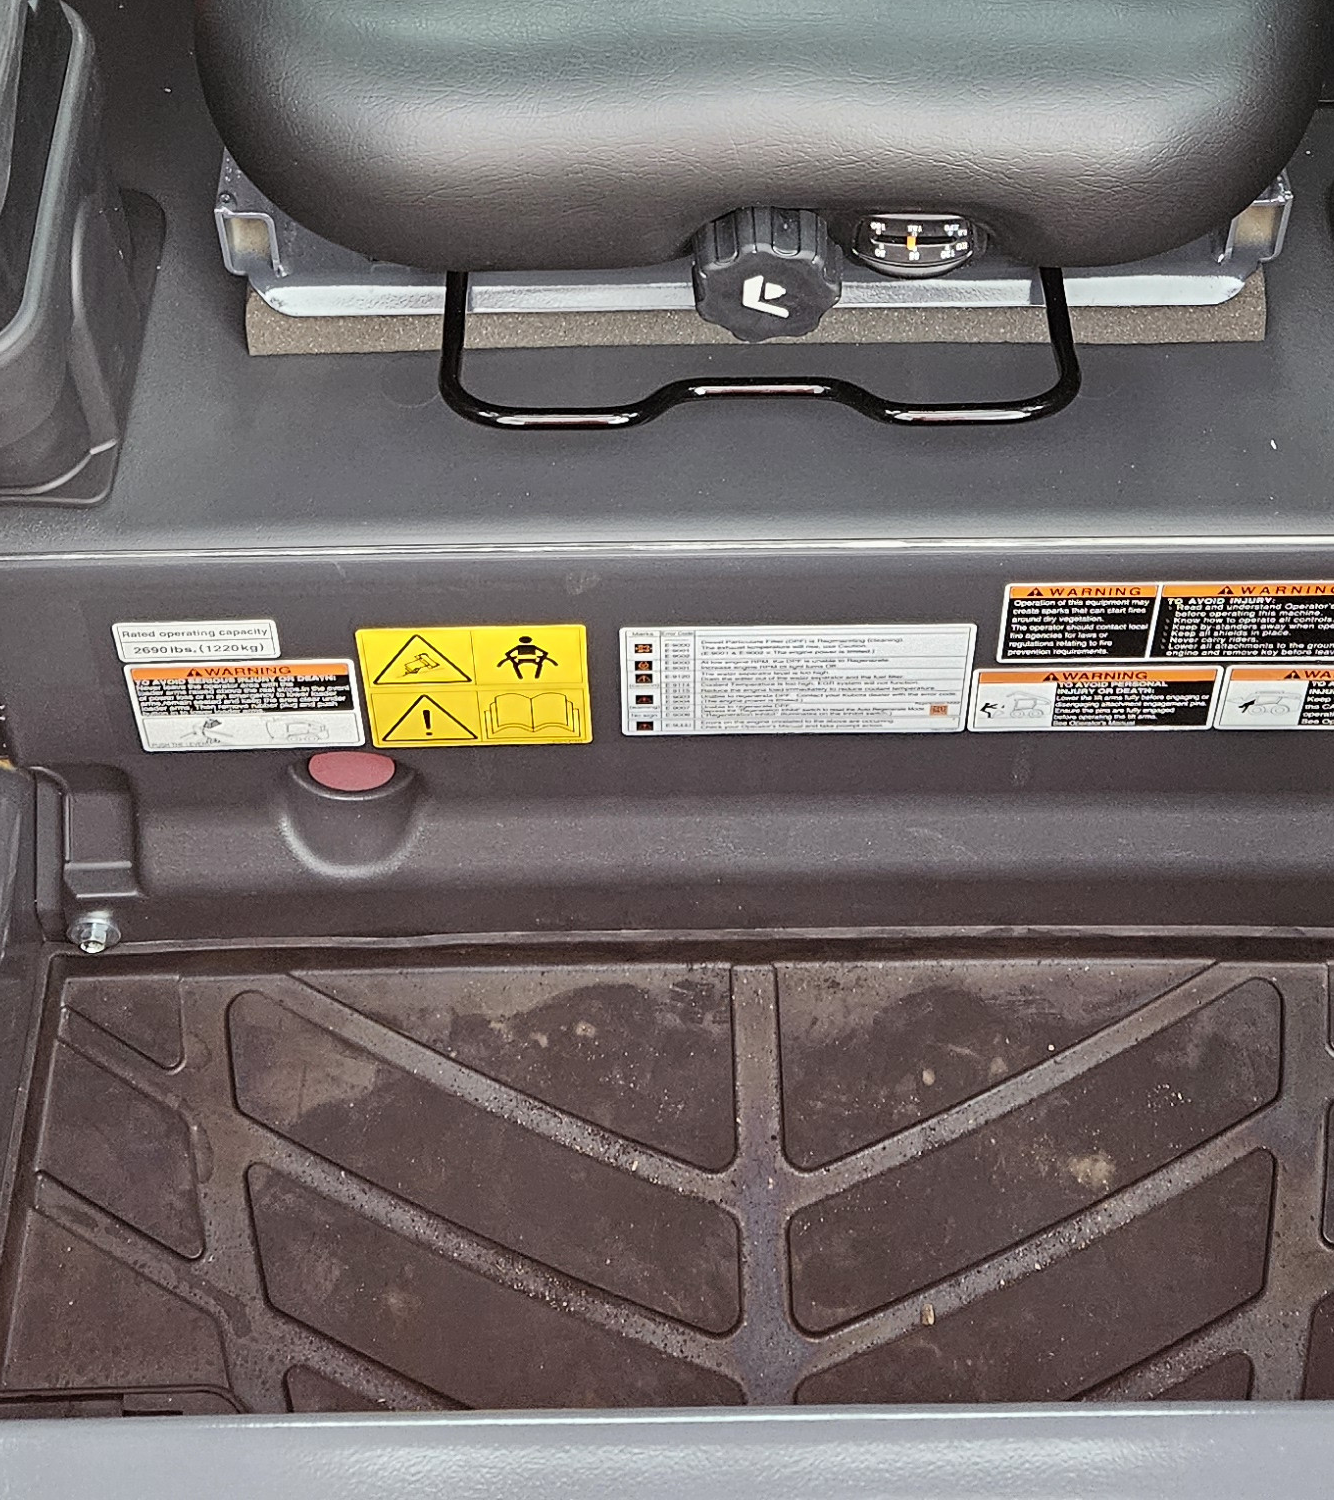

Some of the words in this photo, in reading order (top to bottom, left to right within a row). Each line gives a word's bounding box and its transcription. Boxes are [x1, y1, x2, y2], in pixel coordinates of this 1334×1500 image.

[1048, 586, 1141, 596] WARNING
[1014, 599, 1055, 607] Operation
[1085, 598, 1129, 606] equipment
[1058, 615, 1104, 623] vegetation.
[158, 629, 215, 638] operating
[218, 628, 268, 636] capacity
[1008, 640, 1053, 648] regulations
[1007, 648, 1050, 656] prevention
[1053, 647, 1108, 655] requirements.
[204, 666, 291, 676] WARNING
[1061, 671, 1148, 681] WARNING
